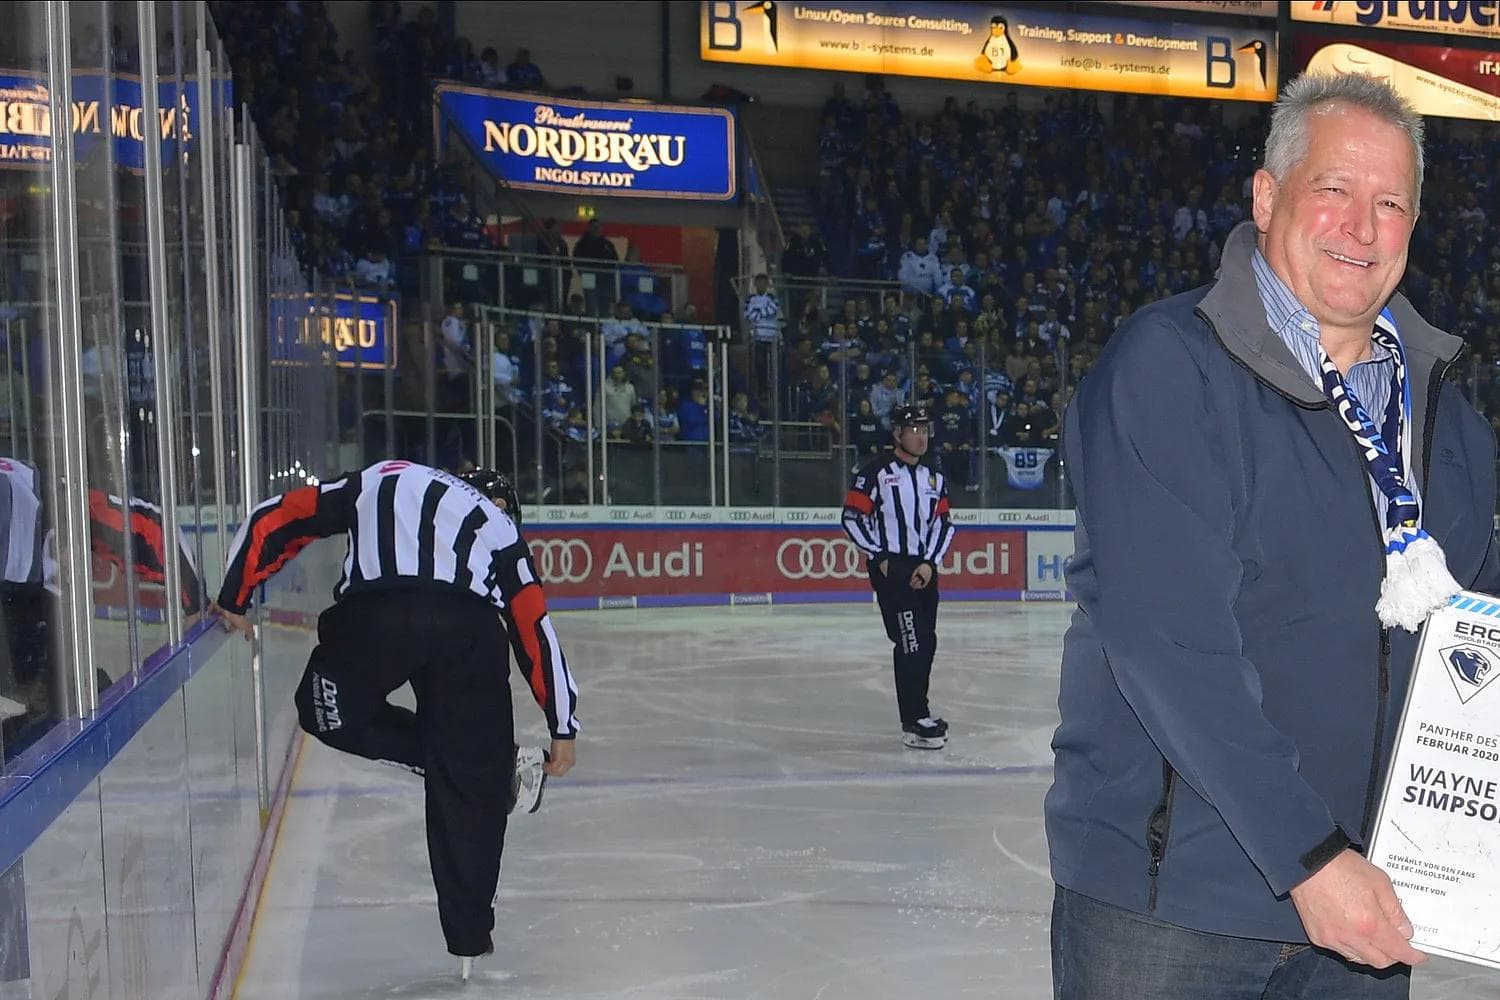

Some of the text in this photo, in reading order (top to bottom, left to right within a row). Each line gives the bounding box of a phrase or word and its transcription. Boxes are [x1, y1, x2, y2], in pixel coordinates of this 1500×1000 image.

[794, 6, 972, 34] Linux/Open Source Consulting,
[820, 38, 935, 57] www.b-systems.de
[1017, 24, 1199, 51] Training, Support & Development
[1060, 56, 1171, 75] info@b-systems.de
[483, 120, 686, 172] NORDBRÄU
[534, 166, 635, 187] INGOLSTADT
[603, 542, 704, 577] Audi
[938, 542, 1010, 576] udi
[1419, 722, 1473, 743] PANTHER
[1476, 735, 1498, 748] DES
[1416, 735, 1499, 762] FEBRUAR 2020
[1410, 763, 1498, 800] WAYNE
[1386, 861, 1462, 884] DES ERC INGOLSTADT.
[1388, 854, 1476, 879] GEWÄHLT VON DEN FANS
[1392, 878, 1447, 897] ÄSENTIERT VON
[1413, 922, 1439, 935] ayern
